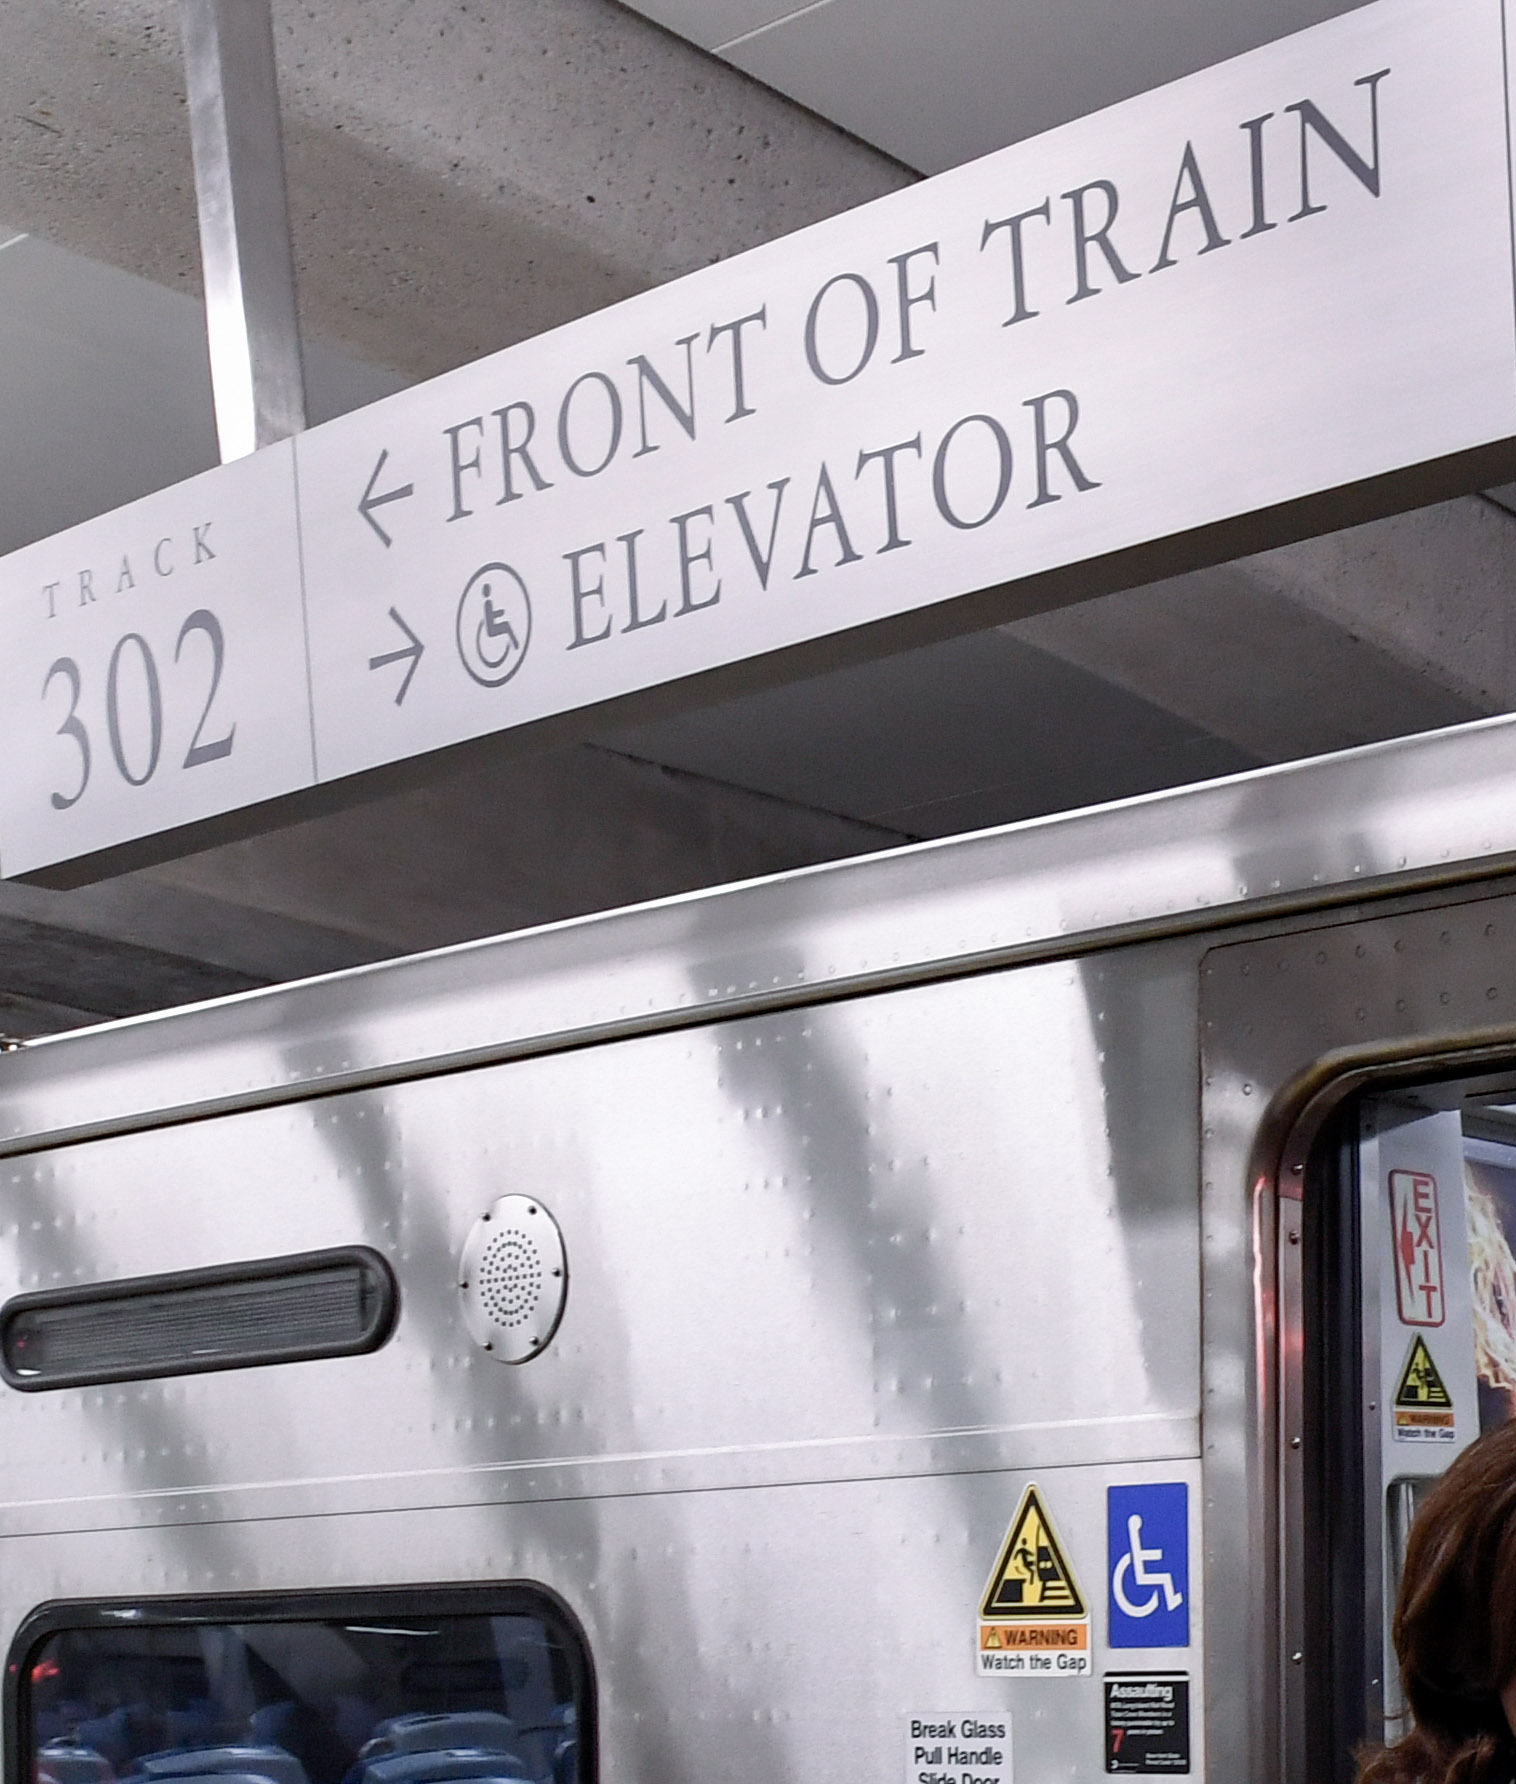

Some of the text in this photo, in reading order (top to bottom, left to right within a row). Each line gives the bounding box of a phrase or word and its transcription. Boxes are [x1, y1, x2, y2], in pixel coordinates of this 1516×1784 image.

[442, 66, 1393, 525] FRONT OF TRAIN
[563, 388, 1104, 653] ELEVATOR
[41, 521, 218, 621] TRACK
[40, 607, 238, 812] 302
[1412, 1177, 1439, 1319] EXIT
[981, 1652, 1087, 1675] Watch the Gap
[1004, 1628, 1079, 1647] WARNING
[910, 1719, 1006, 1739] Break Glass
[914, 1746, 1004, 1766] Pull Handle
[1111, 1728, 1125, 1753] 7
